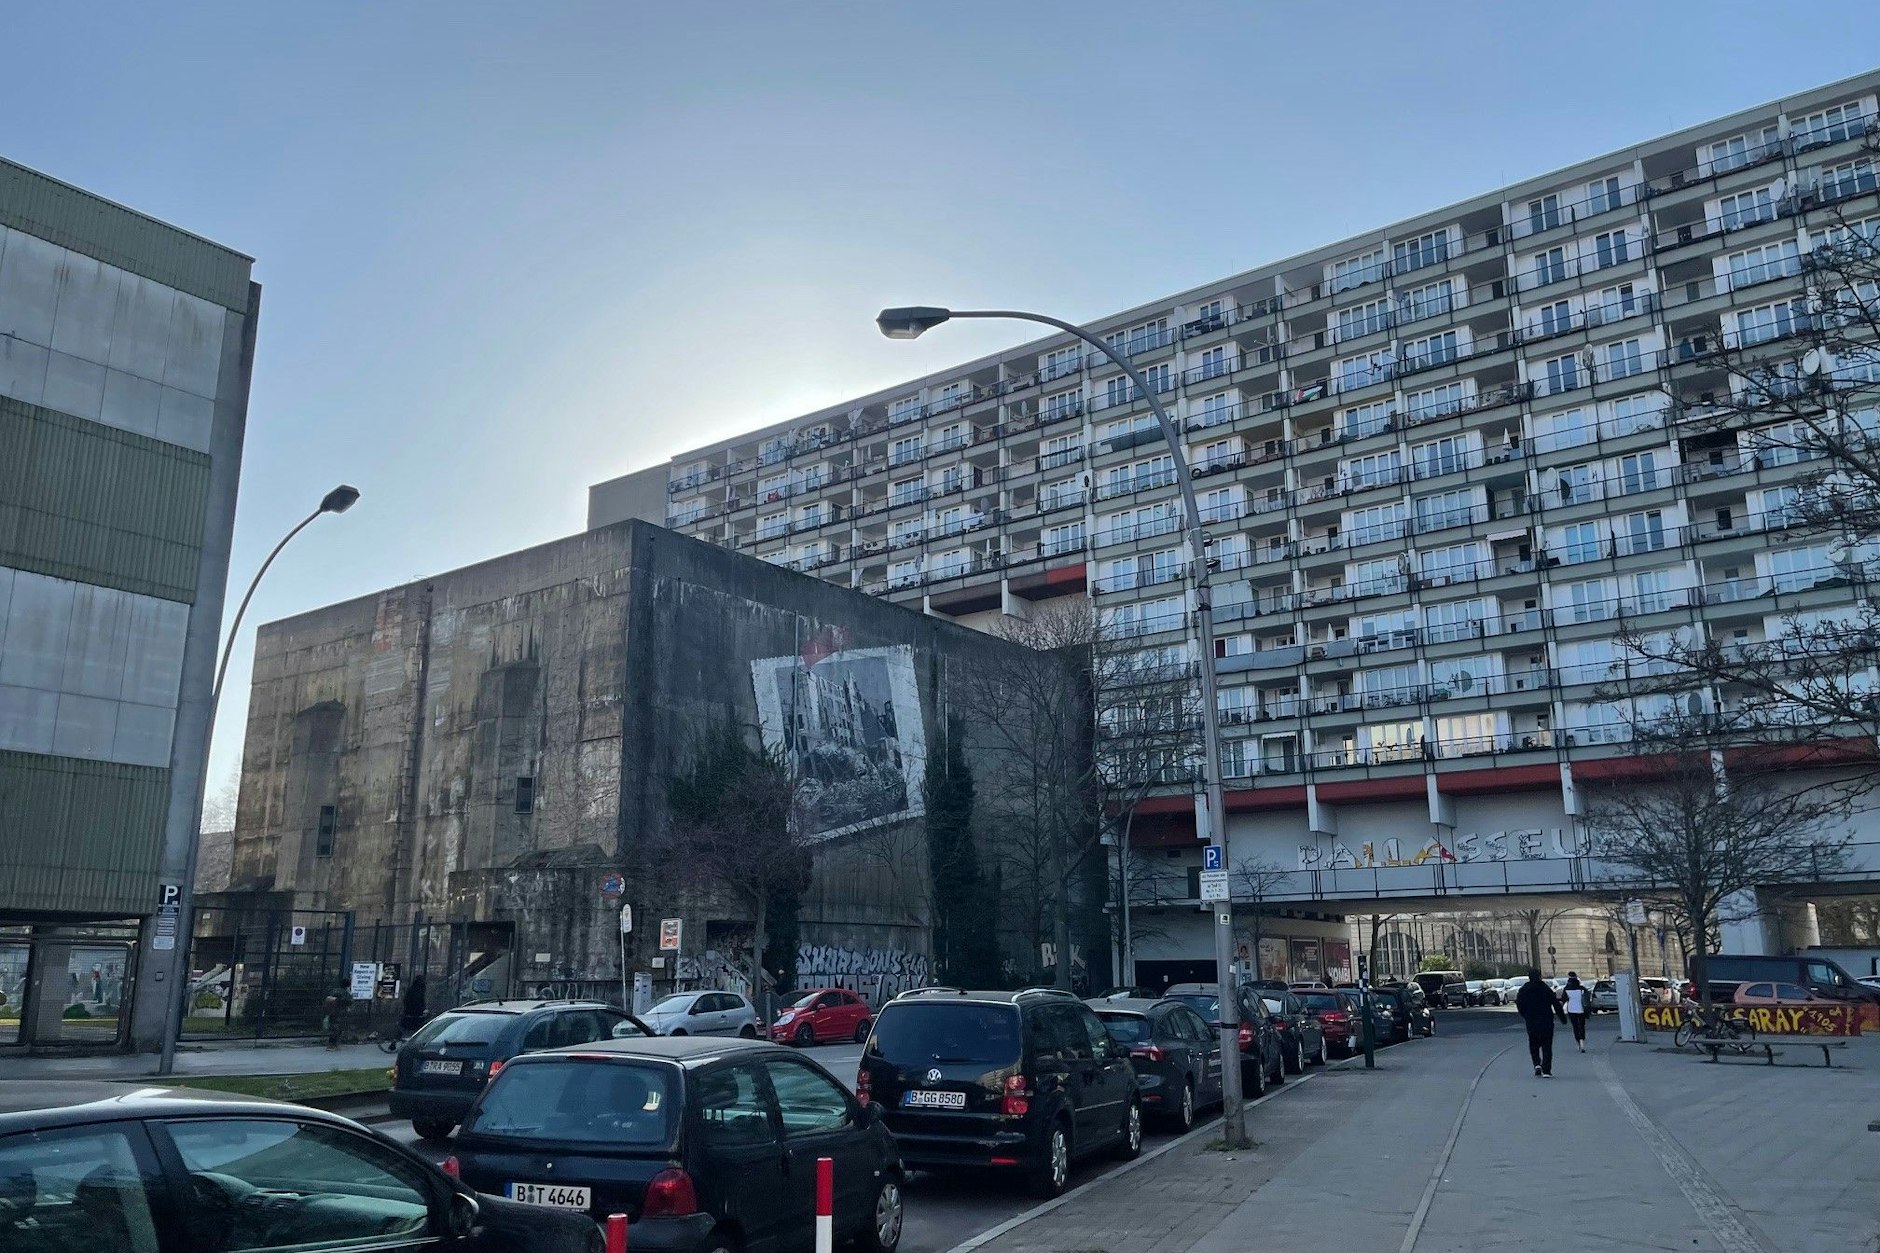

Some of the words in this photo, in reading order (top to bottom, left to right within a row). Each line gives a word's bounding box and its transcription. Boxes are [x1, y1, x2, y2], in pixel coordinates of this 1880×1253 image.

[1206, 848, 1217, 868] P
[164, 885, 178, 904] P
[1643, 1005, 1804, 1034] GALSARAY
[924, 1092, 937, 1103] GG
[939, 1093, 964, 1105] 8580
[517, 1185, 526, 1202] B
[536, 1187, 545, 1204] T
[548, 1188, 585, 1206] 4646
